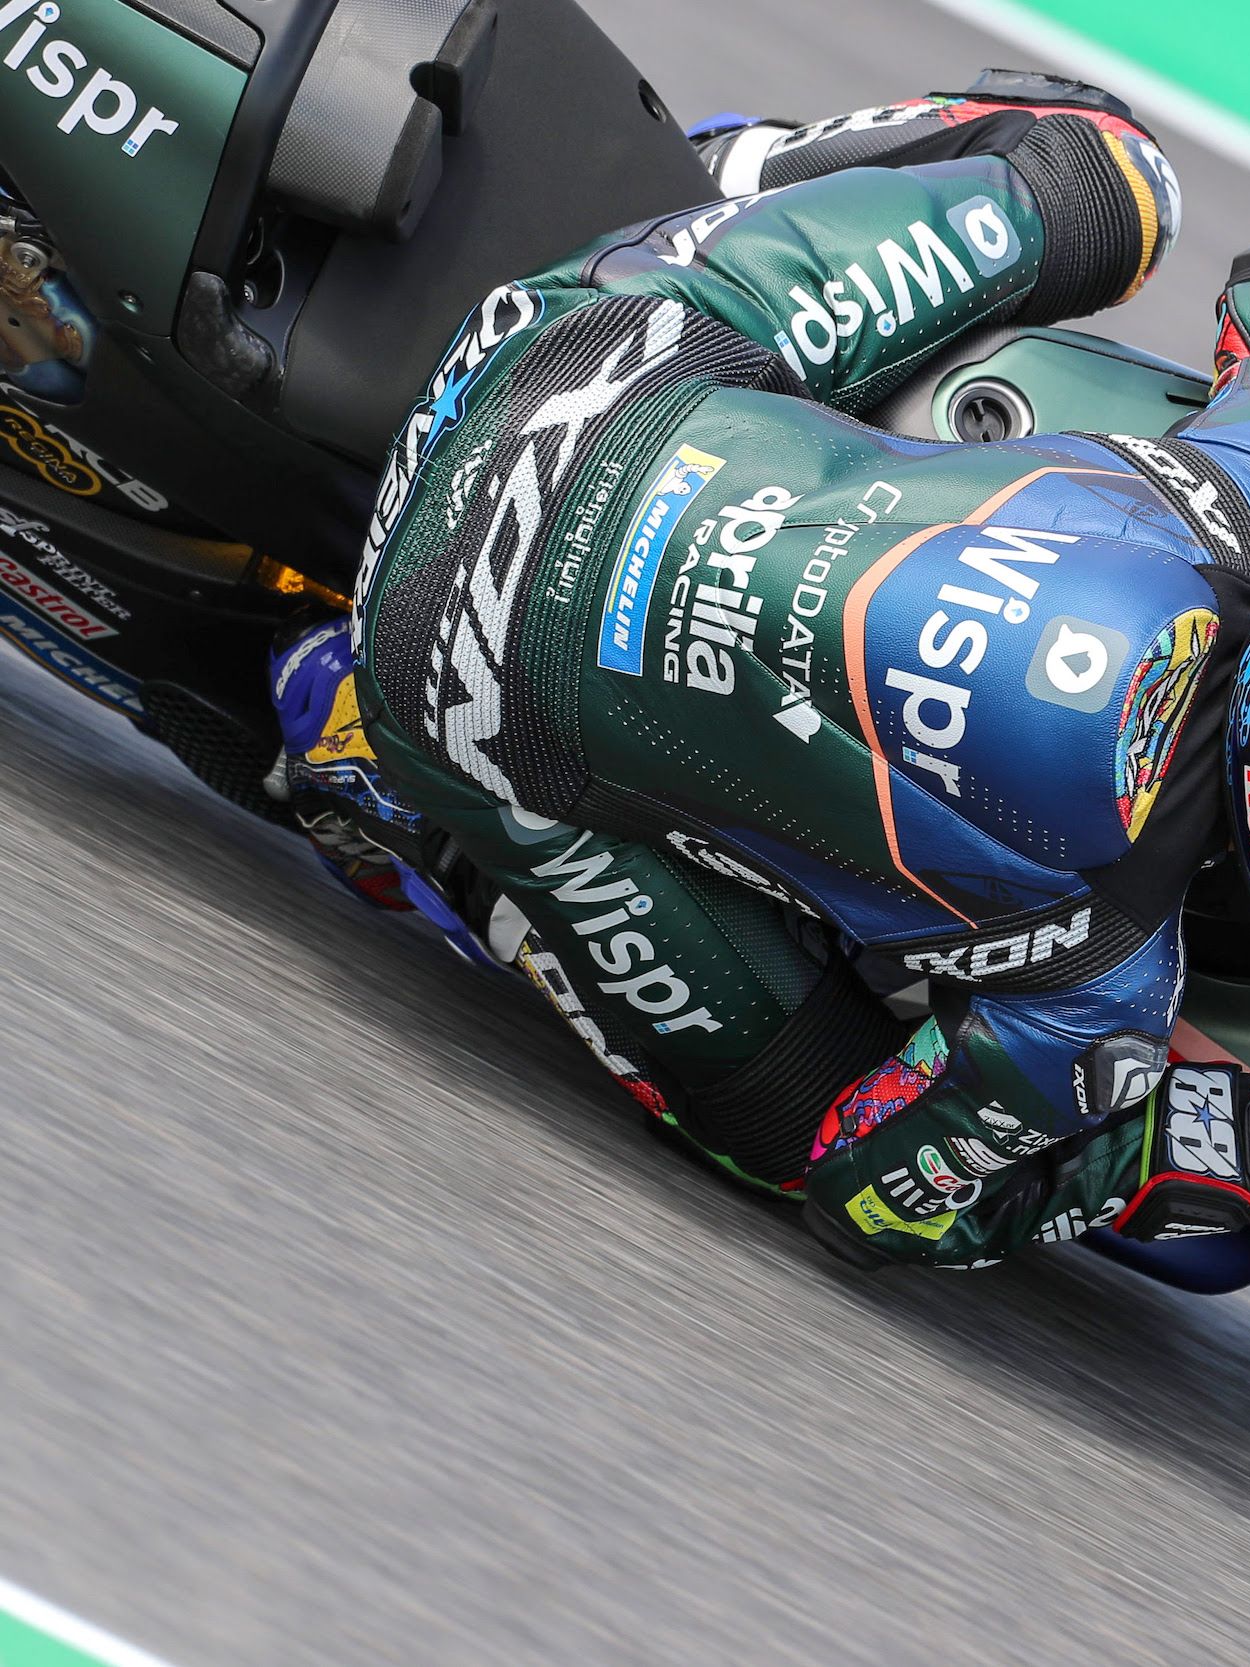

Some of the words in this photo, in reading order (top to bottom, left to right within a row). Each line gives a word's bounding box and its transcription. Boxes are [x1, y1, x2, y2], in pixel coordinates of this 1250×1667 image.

[0, 0, 179, 157] ispr
[614, 499, 670, 651] MICHELIN
[663, 518, 718, 684] RACING
[686, 486, 805, 696] aprilia
[885, 526, 1082, 798] Wispr
[530, 830, 723, 1035] Wispr
